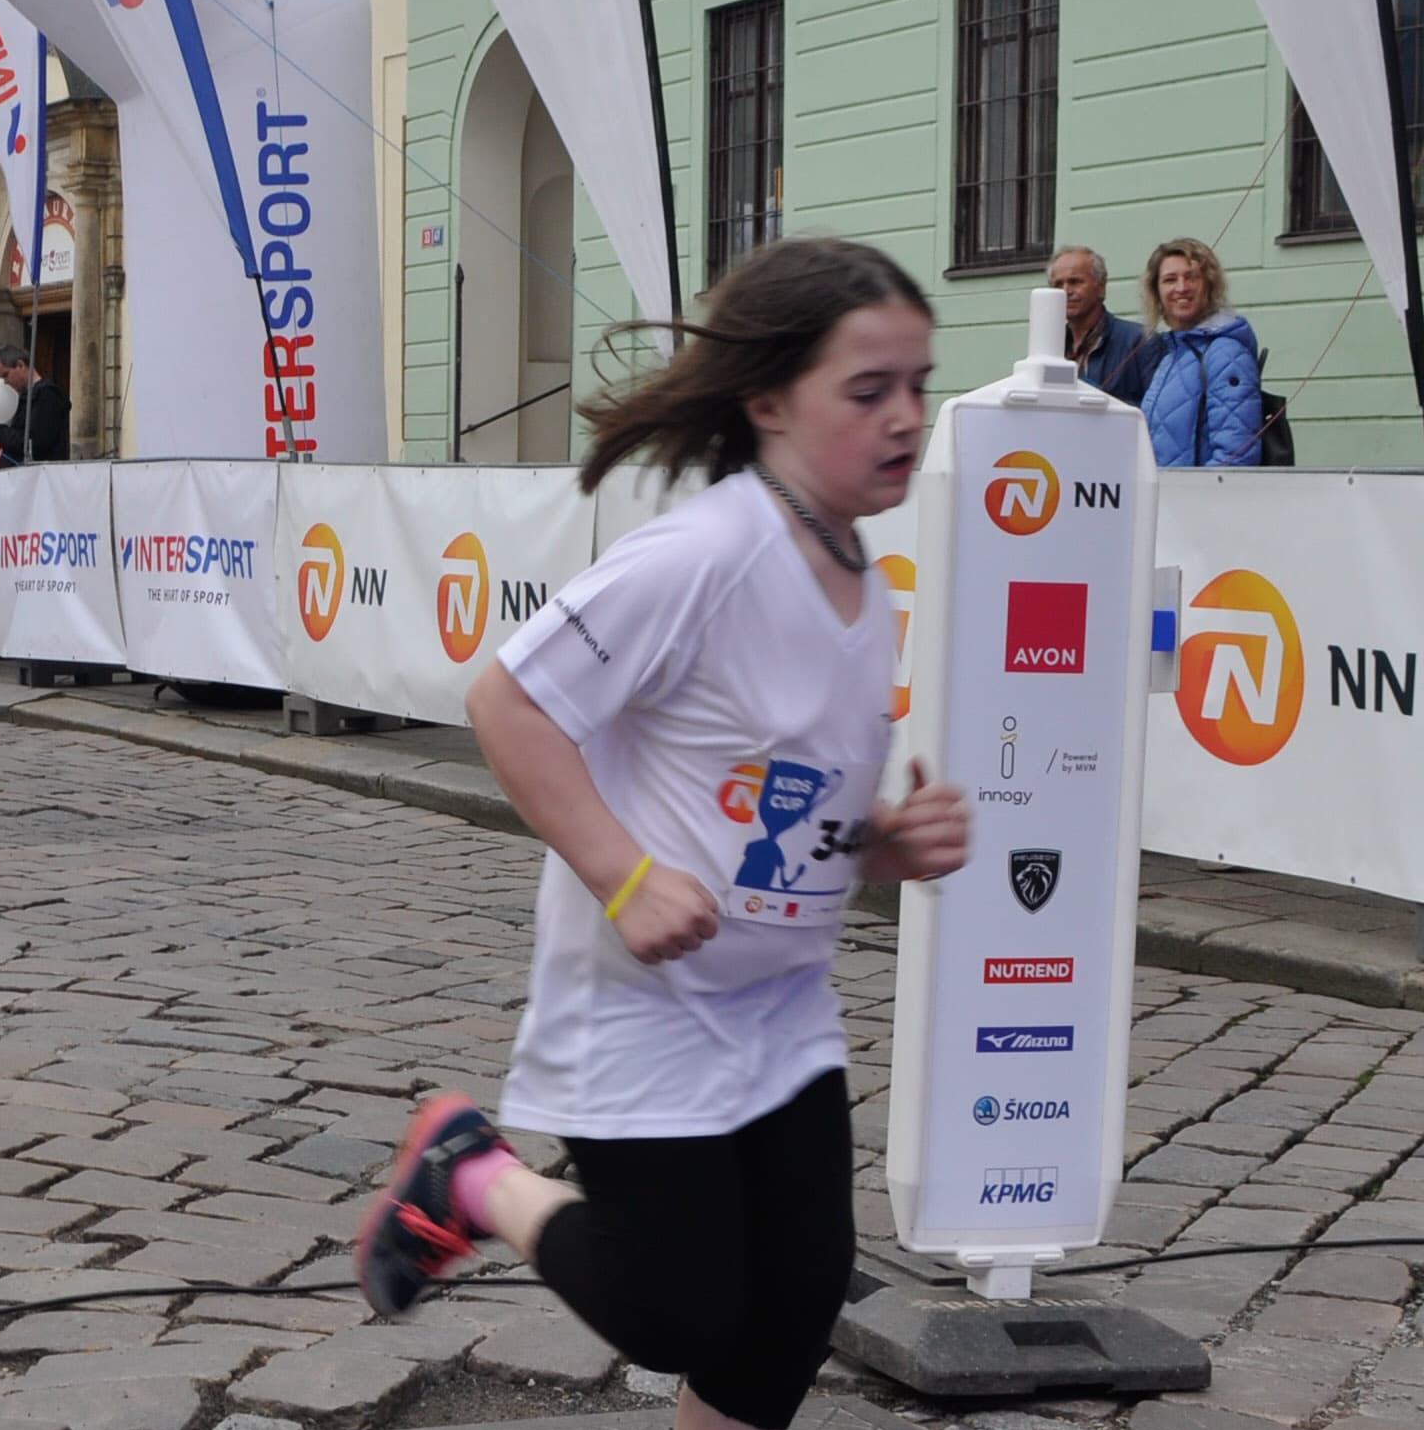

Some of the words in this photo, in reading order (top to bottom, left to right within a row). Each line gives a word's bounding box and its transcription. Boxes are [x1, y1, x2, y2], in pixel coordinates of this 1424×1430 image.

[1074, 482, 1121, 510] NN
[134, 535, 255, 579] INTERSPORT
[47, 580, 76, 593] SPORT
[351, 566, 388, 607] NN
[148, 588, 161, 602] THE
[180, 589, 191, 603] OF
[193, 590, 230, 606] SPORT
[501, 580, 547, 622] NN
[1013, 647, 1077, 666] AVON
[1328, 644, 1417, 717] NN
[1062, 752, 1099, 762] Powered
[1062, 764, 1073, 774] by
[1075, 764, 1097, 772] MVM
[772, 775, 815, 794] KIDS
[768, 794, 806, 811] CUP
[978, 787, 1033, 806] innogy
[989, 962, 1071, 979] NUTREND
[1003, 1098, 1070, 1121] ŠKODA
[980, 1181, 1055, 1205] KPMG
